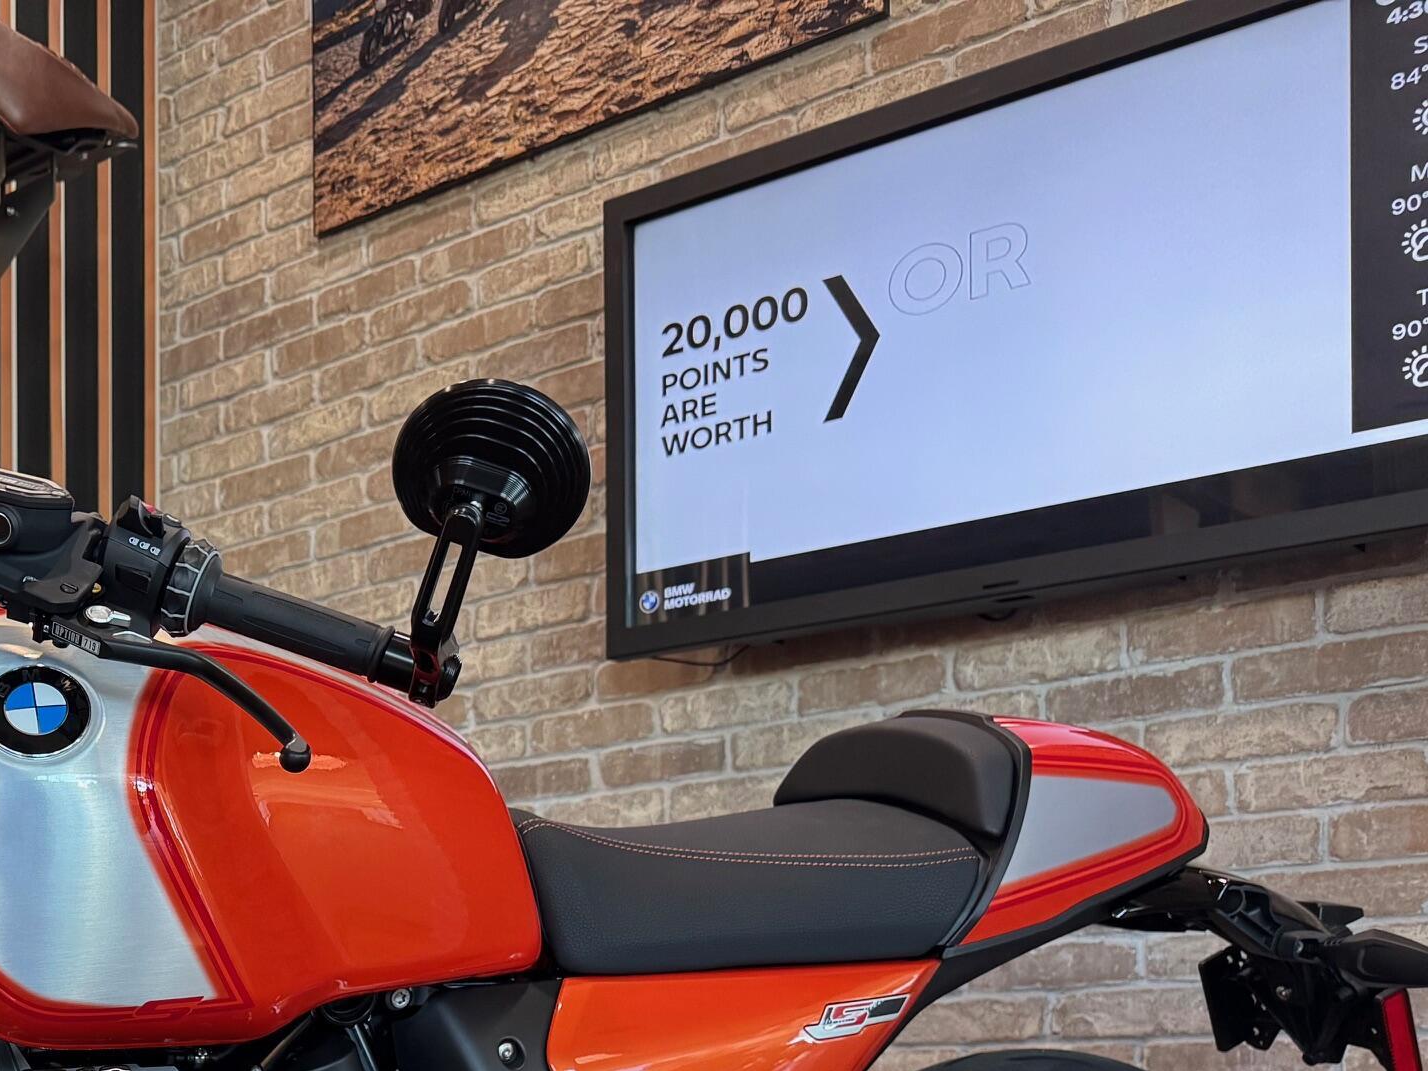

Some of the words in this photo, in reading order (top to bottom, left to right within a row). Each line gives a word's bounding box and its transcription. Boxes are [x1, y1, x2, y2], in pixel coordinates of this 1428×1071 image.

[1386, 1, 1428, 25] 4:3
[889, 222, 1031, 316] OR
[661, 287, 808, 358] 20,000
[661, 348, 770, 397] POINTS
[661, 393, 717, 428] ARE
[661, 411, 772, 457] WORTH
[664, 582, 695, 599] BMW
[664, 587, 732, 611] MOTORRAD
